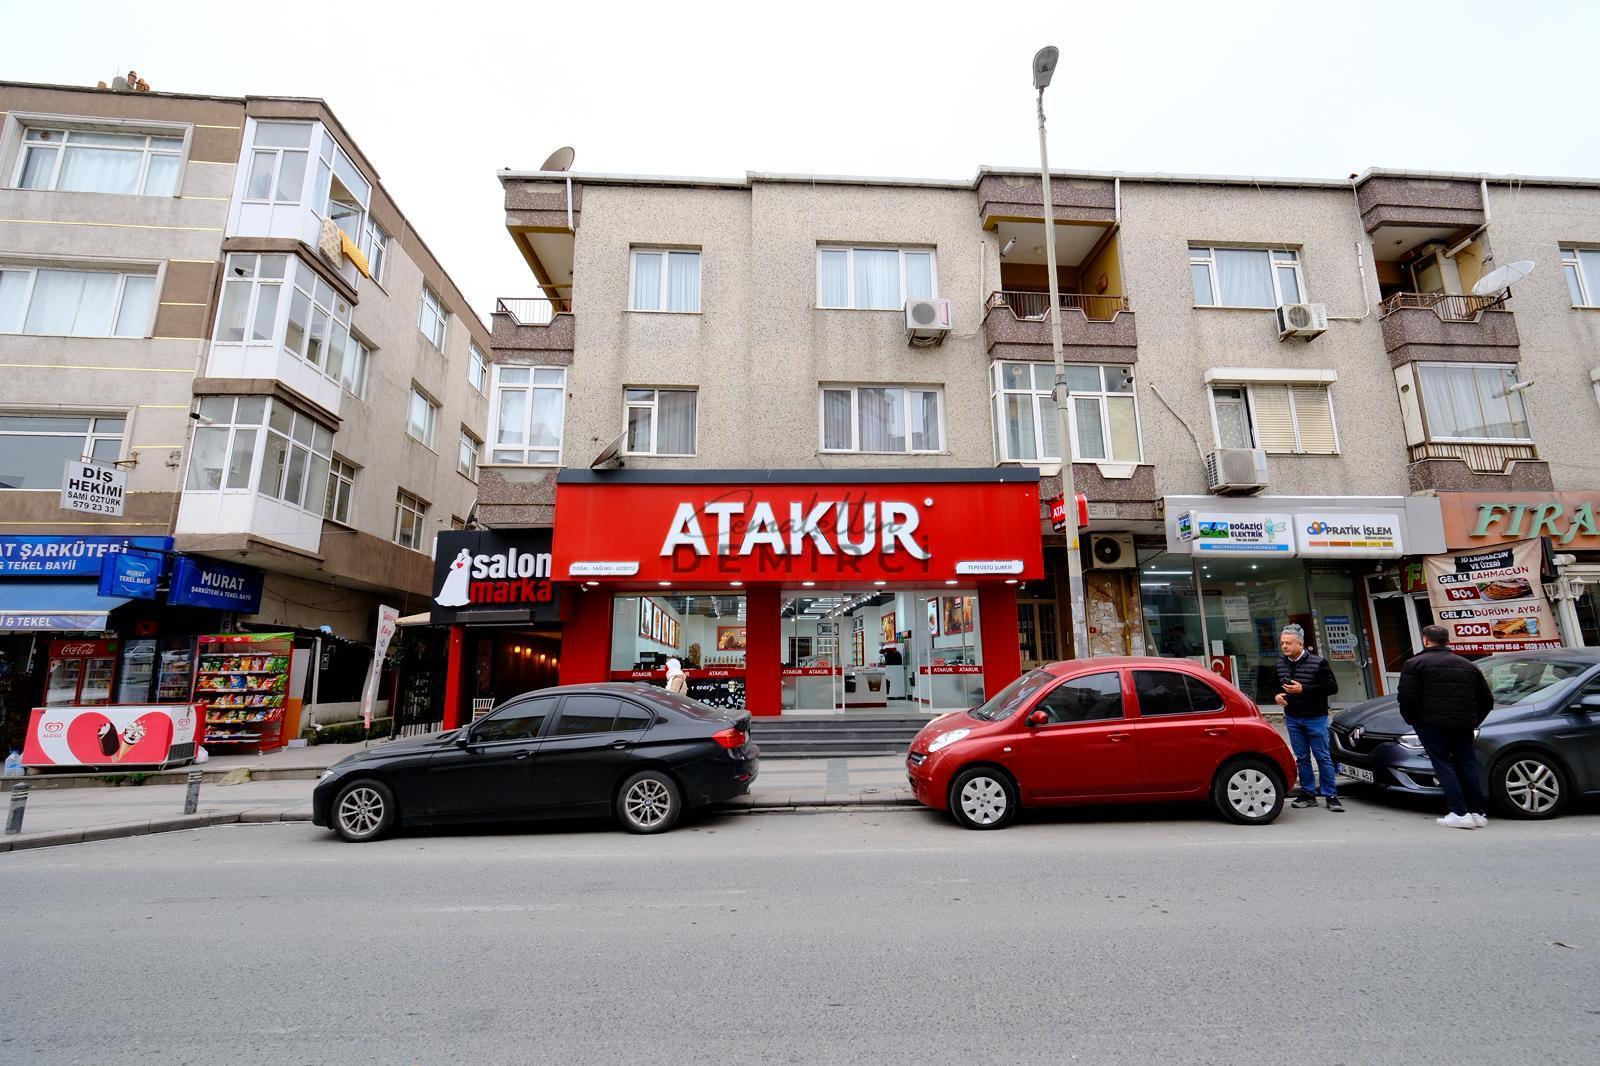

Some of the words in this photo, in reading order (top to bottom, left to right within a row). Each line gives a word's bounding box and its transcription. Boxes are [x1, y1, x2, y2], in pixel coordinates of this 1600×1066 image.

[82, 467, 114, 483] DİŞ
[69, 478, 123, 498] HEKİMİ
[67, 491, 88, 501] SAMİ
[90, 494, 121, 506] ÖZTÜRK
[73, 500, 90, 509] 579
[91, 503, 102, 511] 23
[104, 505, 115, 513] 33
[660, 501, 932, 560] ATAKUR
[1229, 522, 1263, 531] BOĞAZİÇİ
[1326, 525, 1361, 535] PRATİK
[1363, 525, 1392, 536] İŞLEM
[1468, 502, 1600, 545] FIRA
[1230, 530, 1263, 538] ELEKTRİK
[20, 540, 129, 560] ŞARKÜTERİ
[7, 561, 43, 570] TEKEL
[45, 559, 77, 570] BAYİİ
[471, 547, 552, 579] salon
[119, 575, 136, 583] TEKEL
[201, 571, 245, 591] MURAT
[1439, 575, 1457, 583] GEL
[1471, 566, 1529, 580] LAHMACUN
[224, 591, 239, 600] TEKEL
[469, 577, 552, 604] marka
[6, 617, 14, 627] &
[17, 617, 52, 627] TEKEL
[1441, 611, 1460, 619] GEL
[1460, 610, 1473, 618] AL
